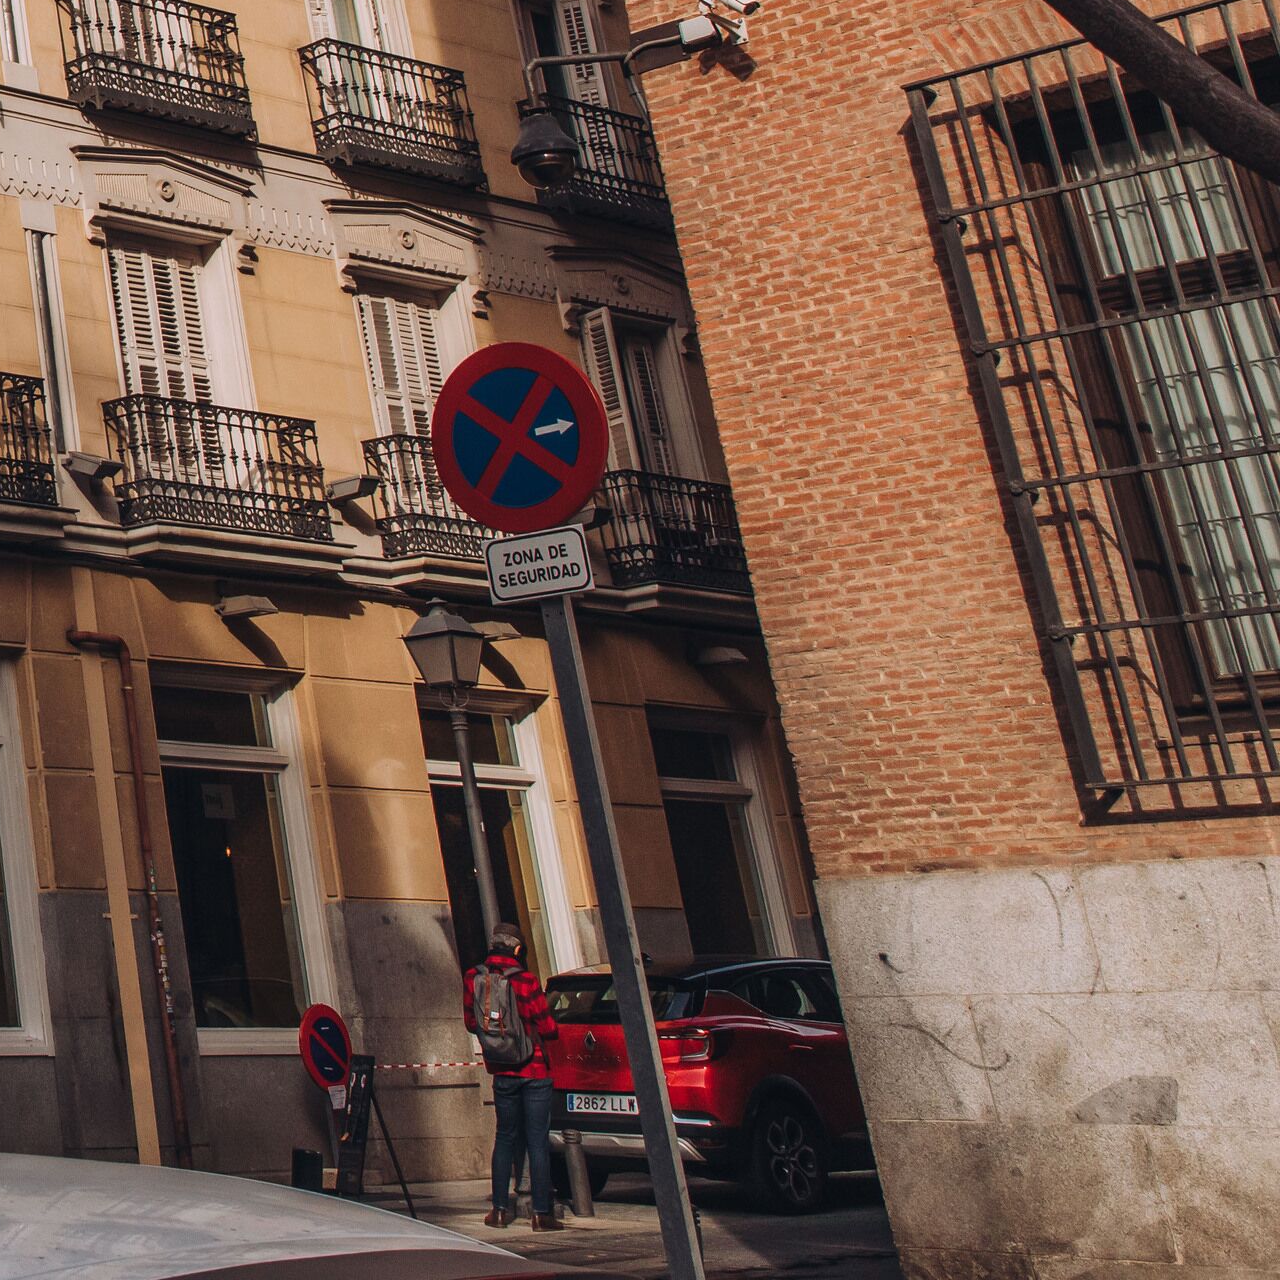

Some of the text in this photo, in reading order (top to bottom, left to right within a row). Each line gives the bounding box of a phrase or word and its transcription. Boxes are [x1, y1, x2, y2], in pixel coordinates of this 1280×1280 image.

[503, 543, 568, 567] ZONA DE
[499, 562, 581, 588] SEGURIDAD
[576, 1096, 607, 1111] 2862
